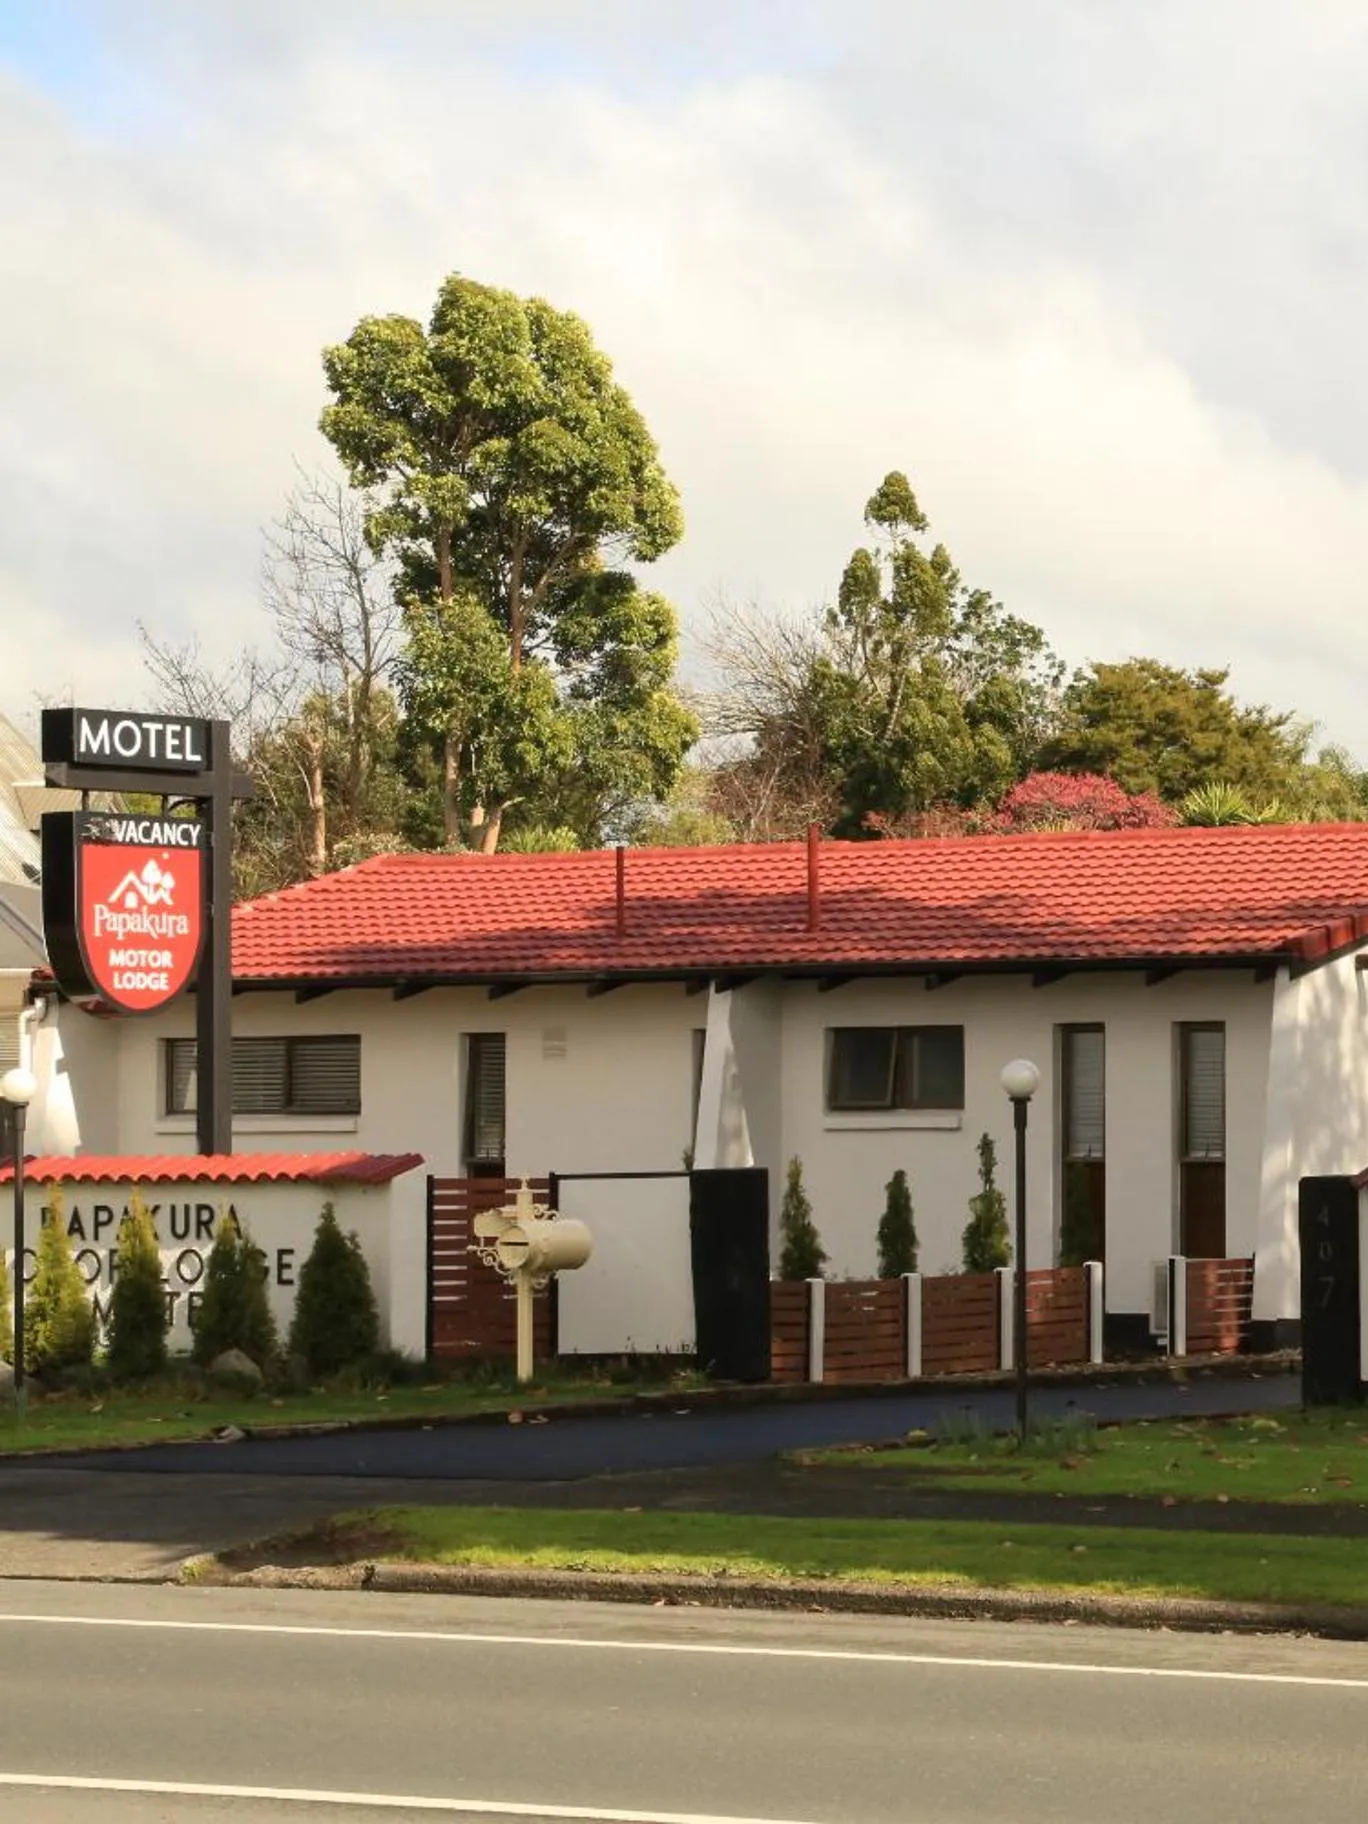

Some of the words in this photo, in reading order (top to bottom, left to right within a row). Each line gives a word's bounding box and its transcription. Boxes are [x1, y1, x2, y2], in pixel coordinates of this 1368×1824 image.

[80, 716, 202, 761] MOTEL
[112, 819, 201, 846] VACANCY
[93, 904, 189, 940] Papakura
[108, 948, 173, 968] MOTOR
[113, 971, 169, 990] LODGE
